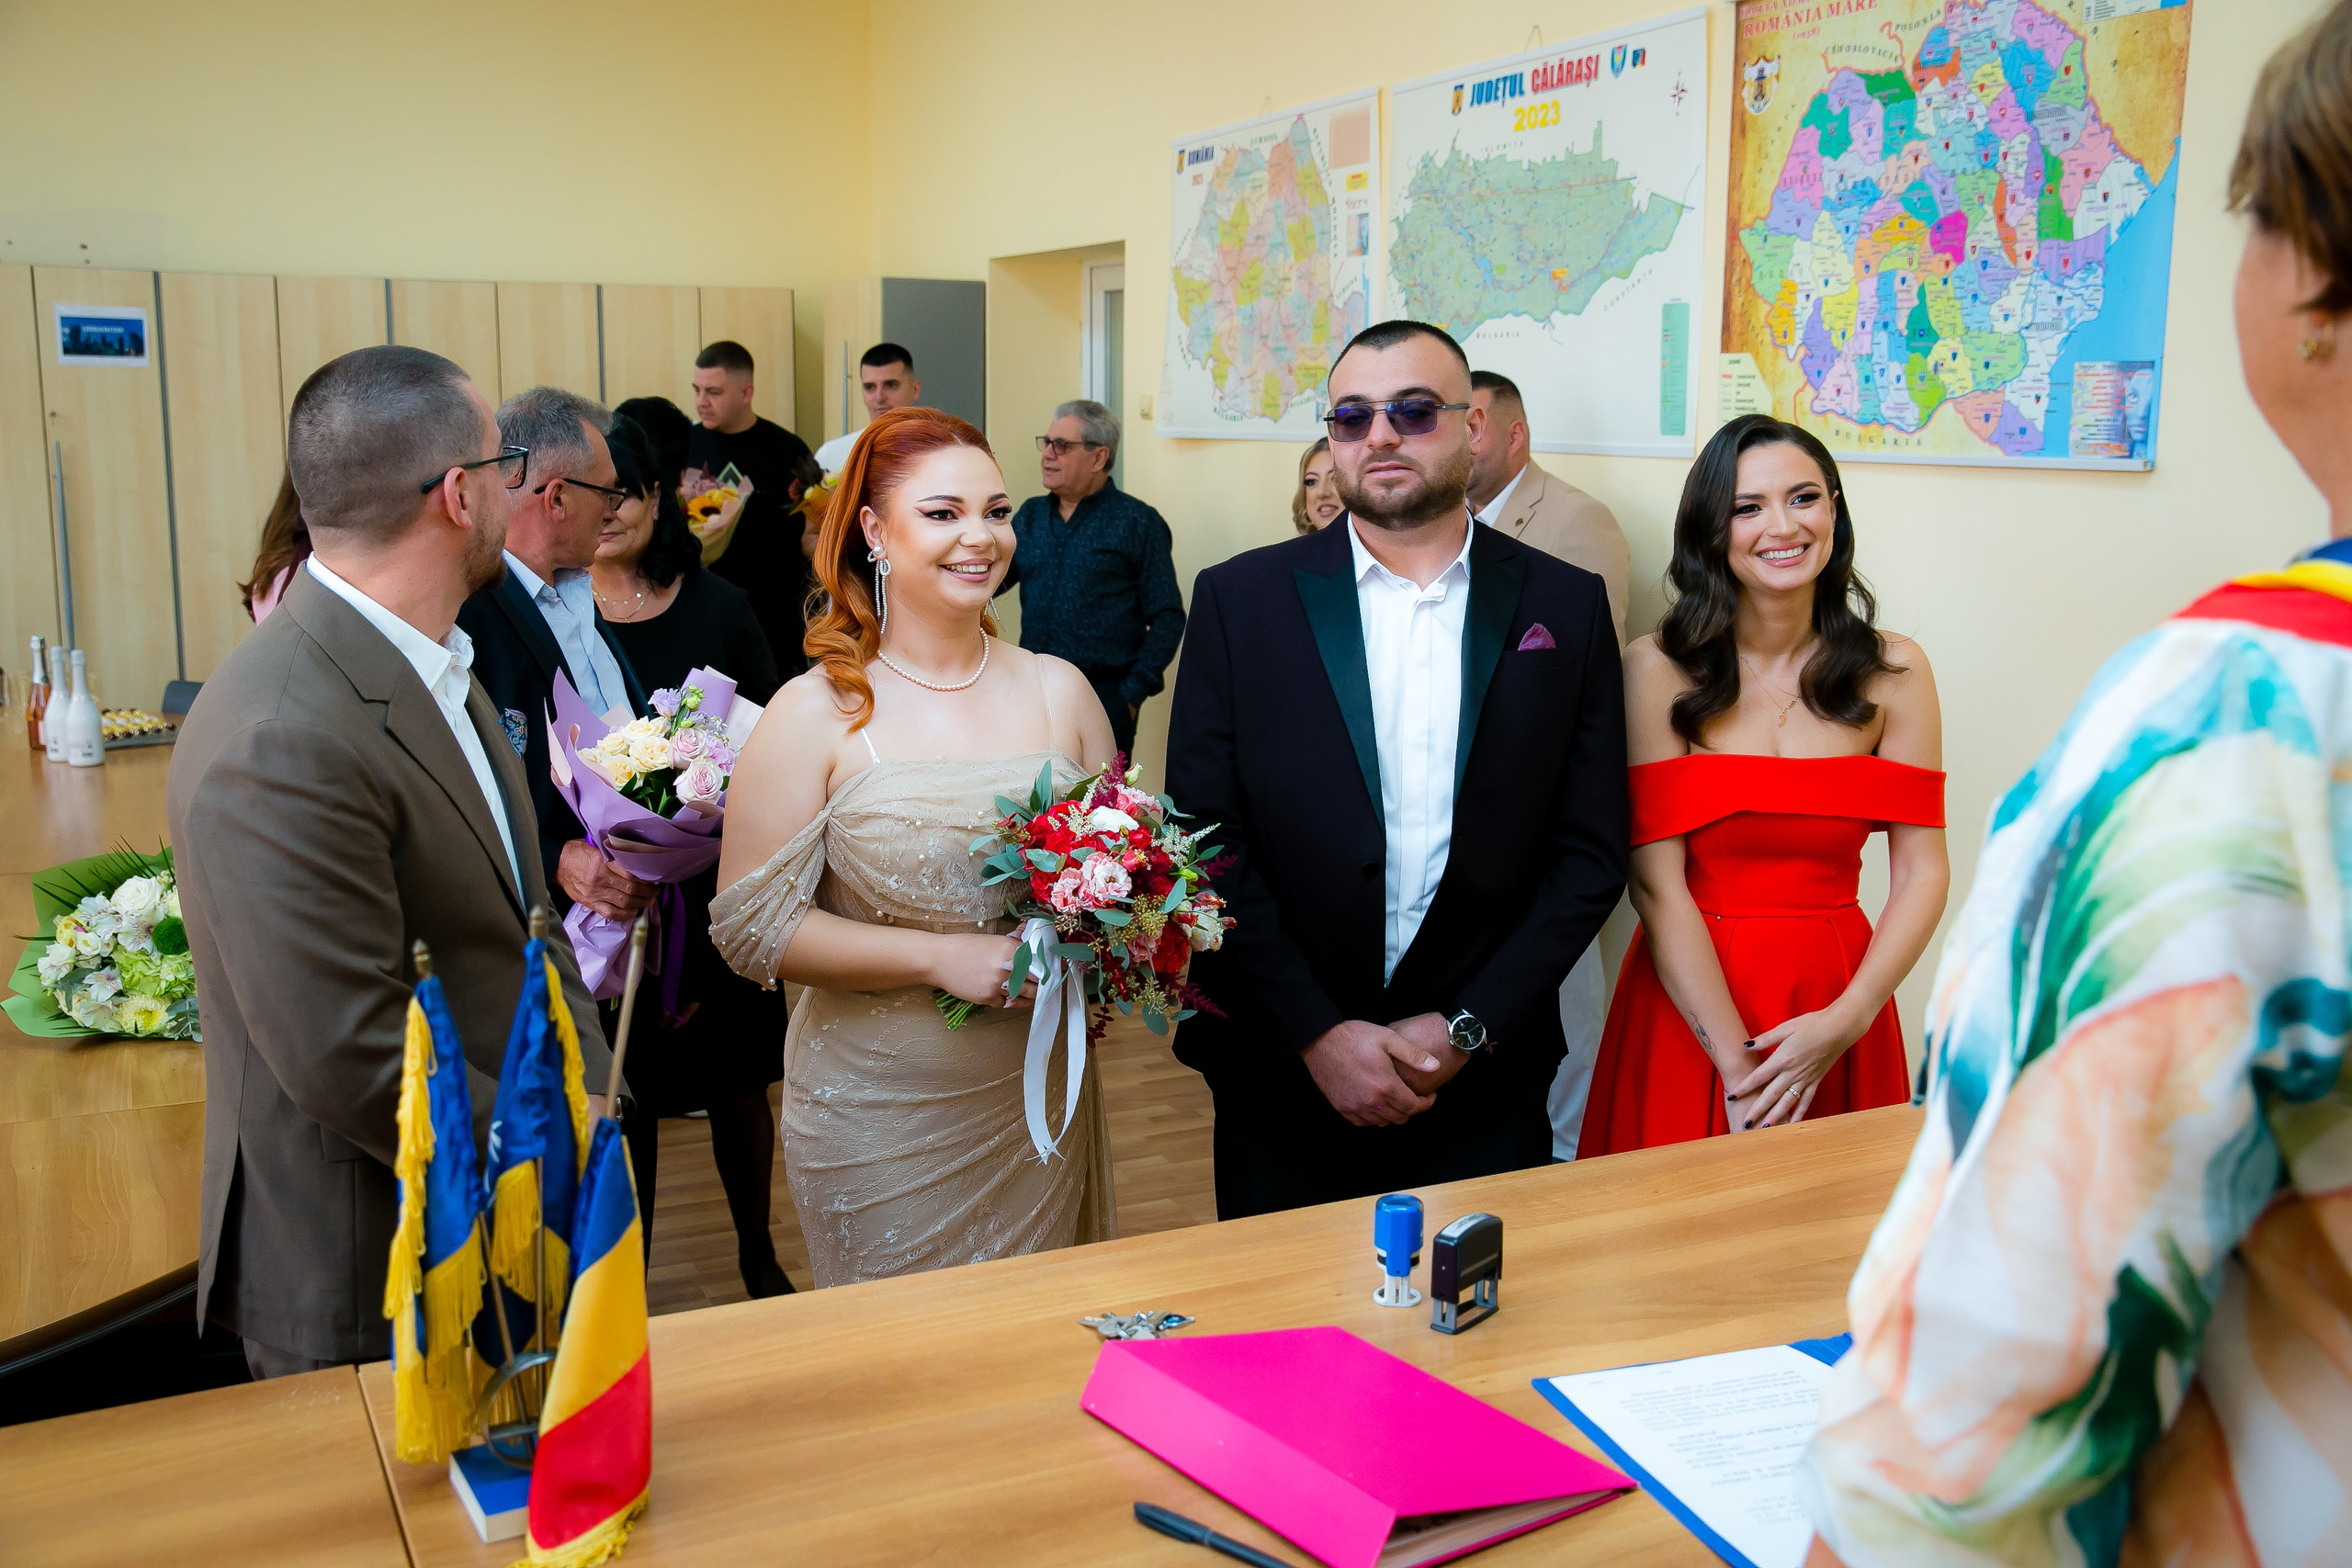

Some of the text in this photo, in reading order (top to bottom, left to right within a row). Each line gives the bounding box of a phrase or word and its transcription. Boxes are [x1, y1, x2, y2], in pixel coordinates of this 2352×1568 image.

[1743, 0, 1878, 39] ROMÂNIA MARE
[1470, 54, 1600, 107] JUDEȚUL CĂLĂRAȘI
[1513, 99, 1561, 132] 2023
